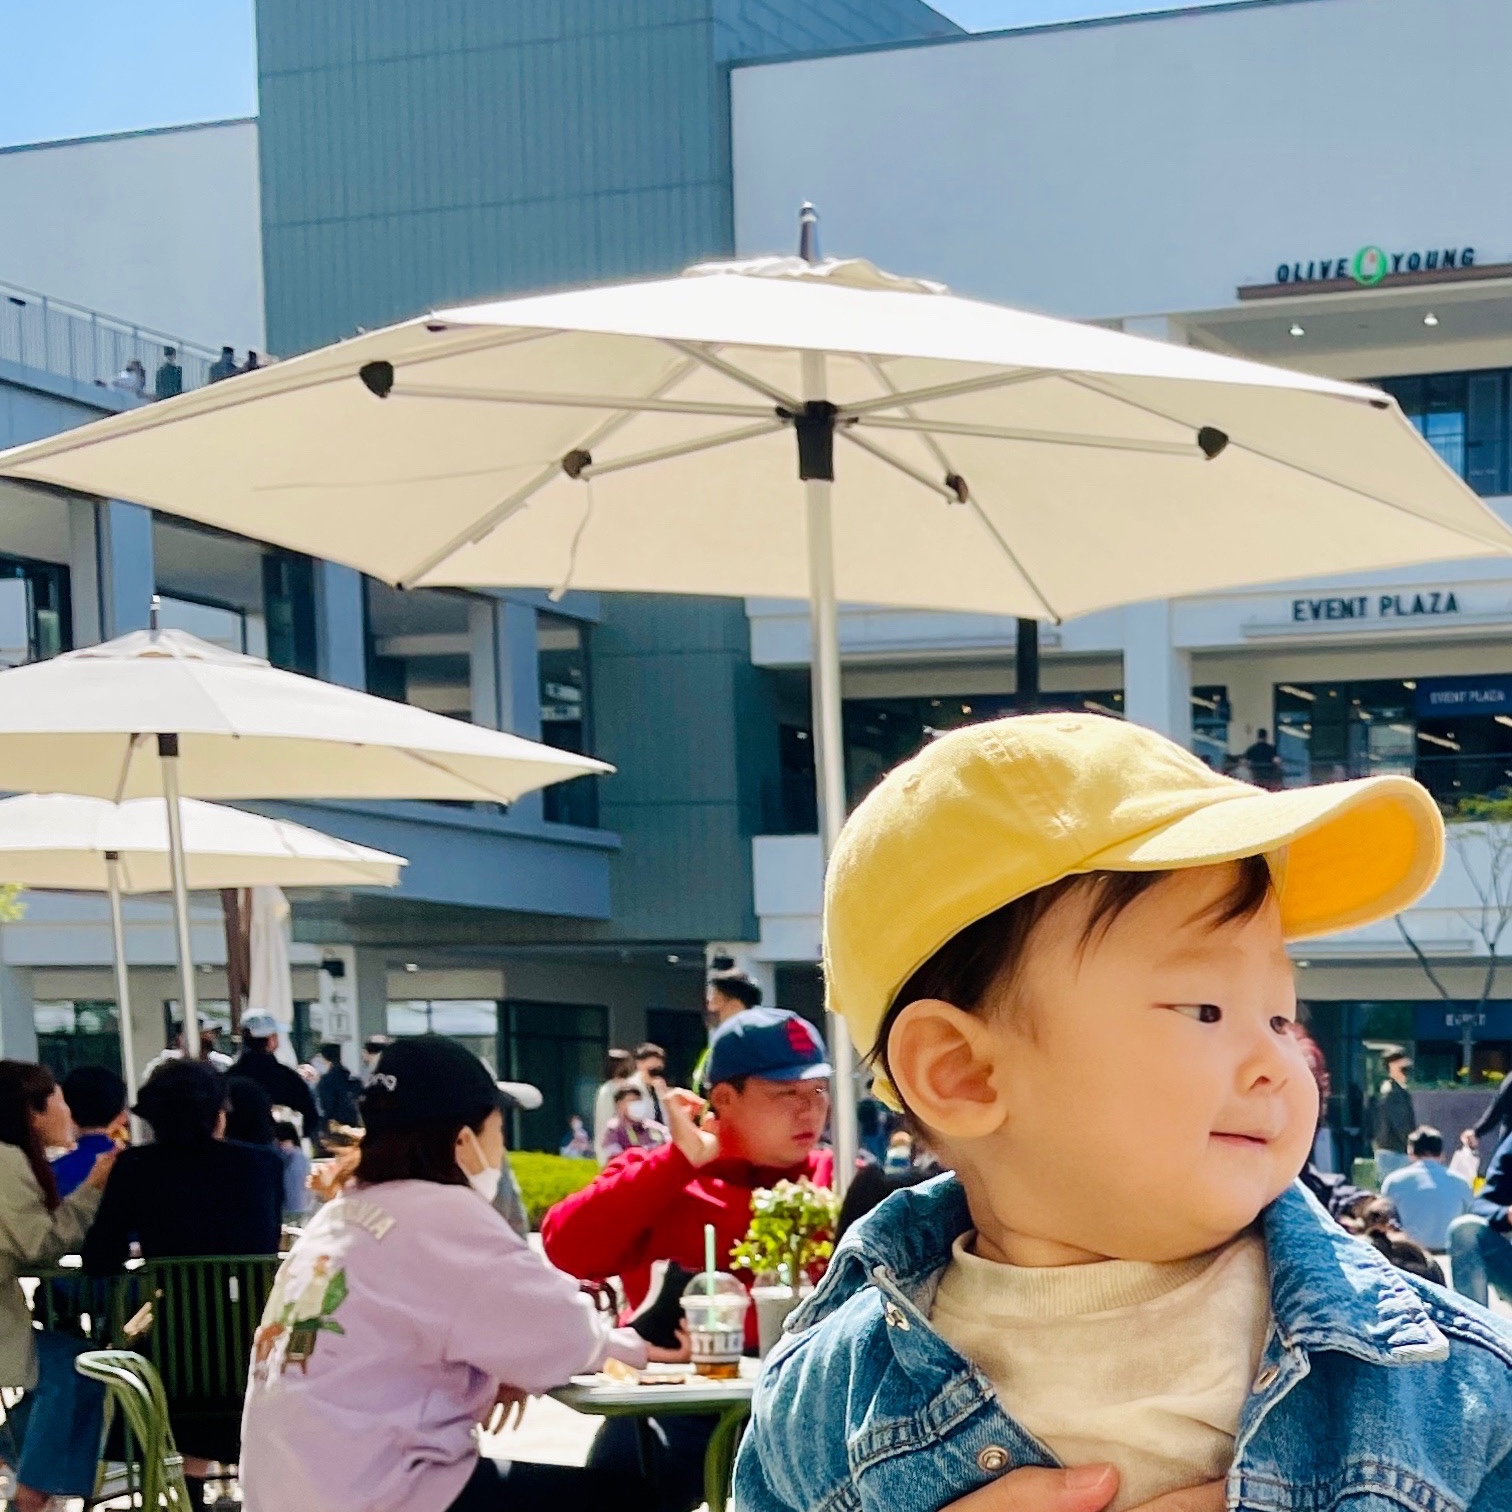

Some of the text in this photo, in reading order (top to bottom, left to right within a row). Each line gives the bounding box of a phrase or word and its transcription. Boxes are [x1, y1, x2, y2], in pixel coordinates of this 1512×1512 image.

[1277, 247, 1475, 283] OLIVE YOUNG
[1292, 592, 1460, 622] EVENT PLAZA
